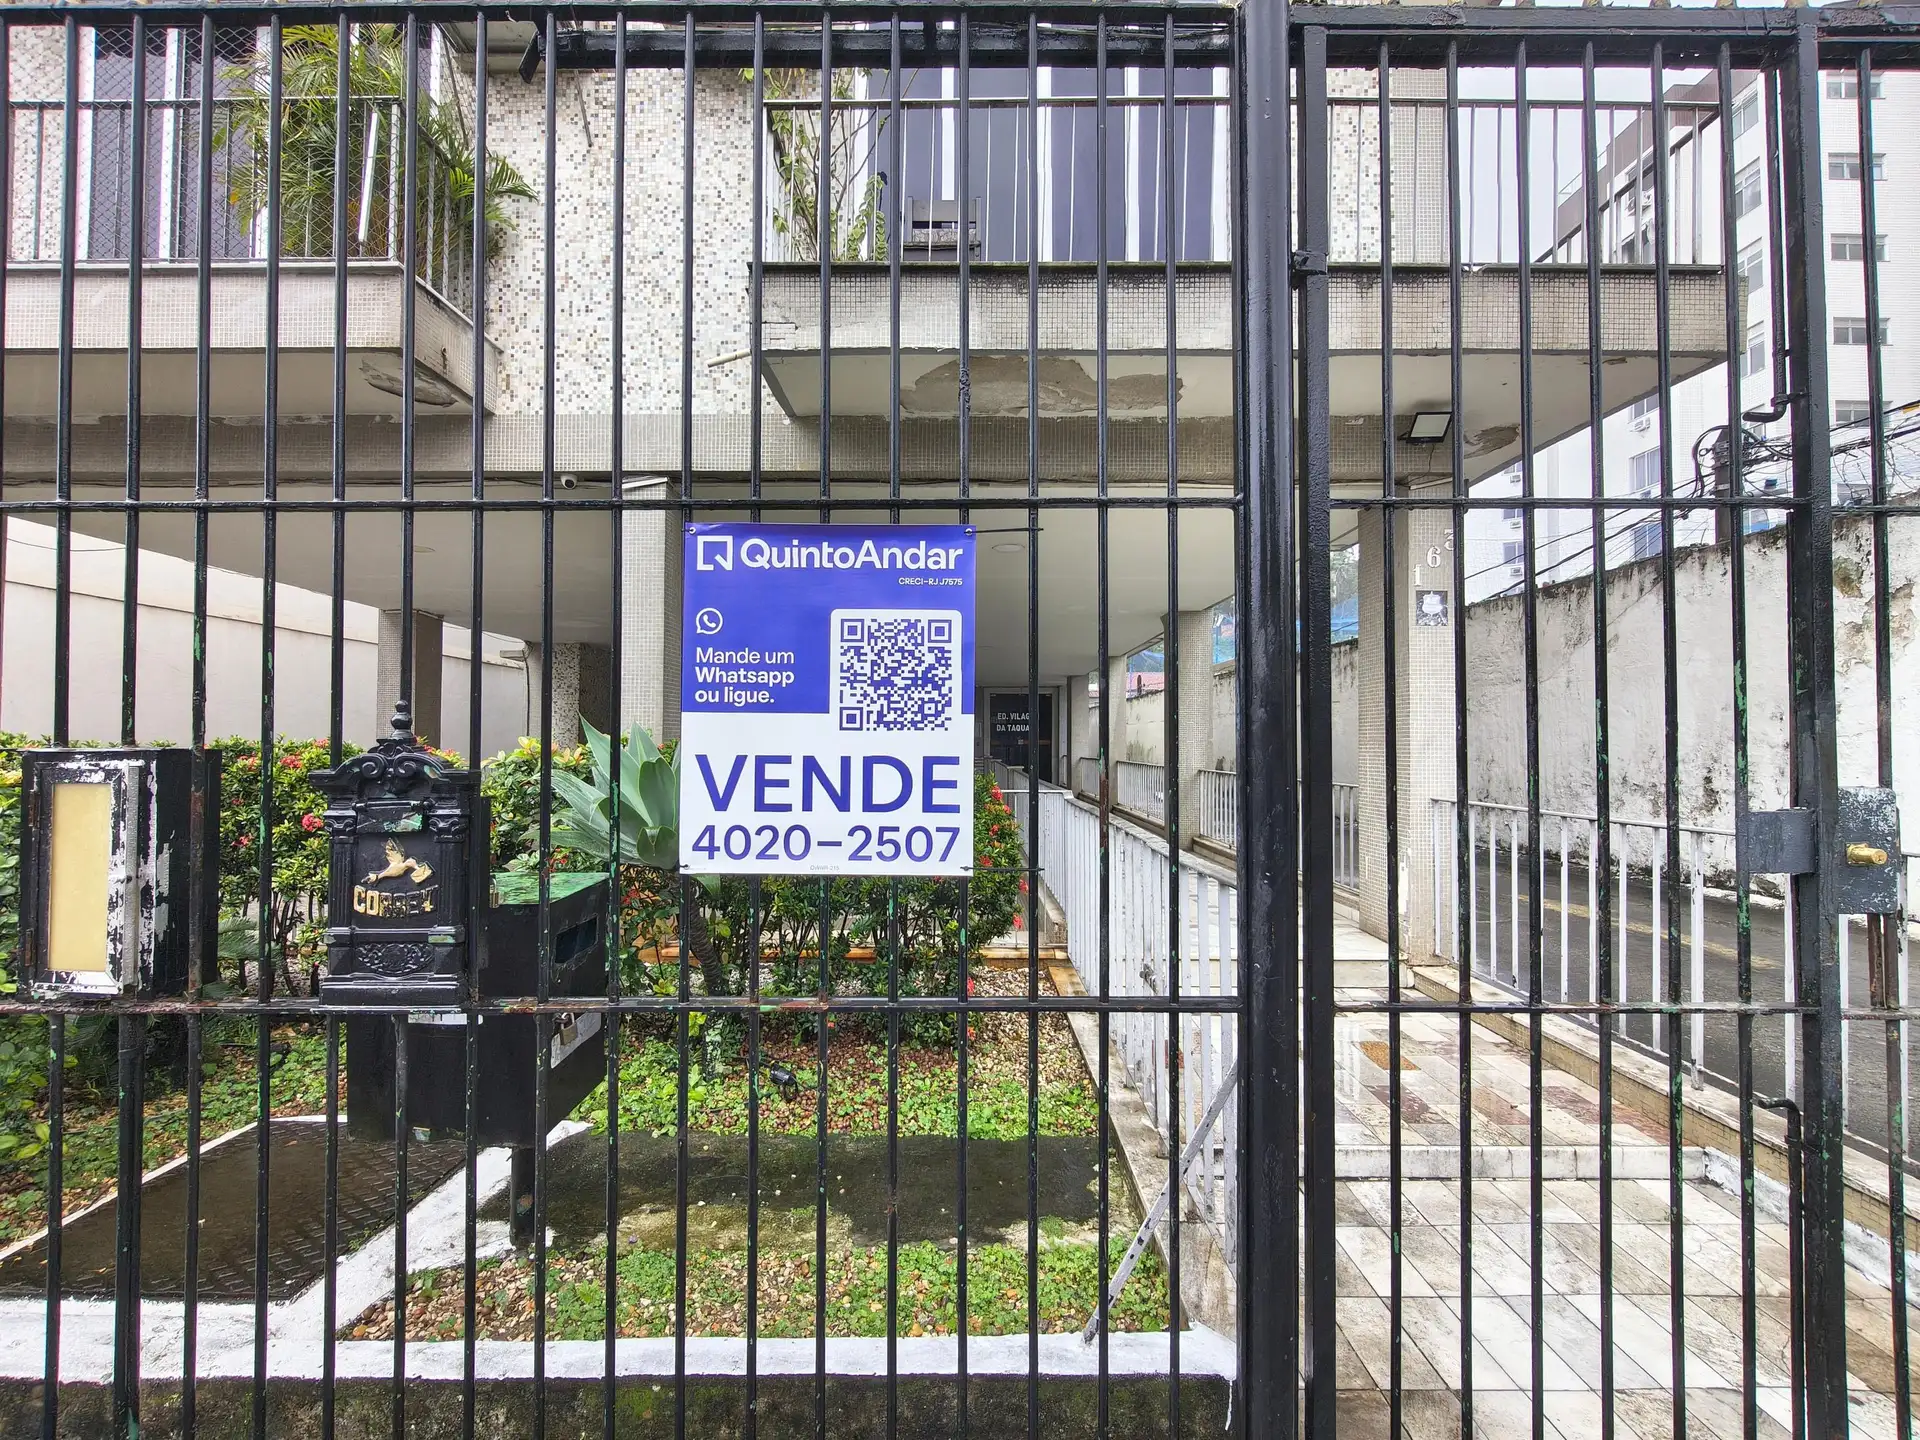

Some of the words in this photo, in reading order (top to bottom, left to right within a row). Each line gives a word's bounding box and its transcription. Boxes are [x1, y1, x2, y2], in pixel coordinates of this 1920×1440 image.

[740, 538, 964, 571] QuintoAndar
[898, 577, 939, 586] CRECI-RJ
[939, 577, 963, 586] J7575
[696, 646, 761, 664] Mande
[765, 650, 795, 664] um
[695, 666, 795, 687] Whatsapp
[694, 690, 720, 704] ou
[724, 686, 775, 707] ligue.
[996, 724, 1006, 732] DA
[695, 753, 961, 814] VENDE
[692, 823, 961, 863] 4020-2507
